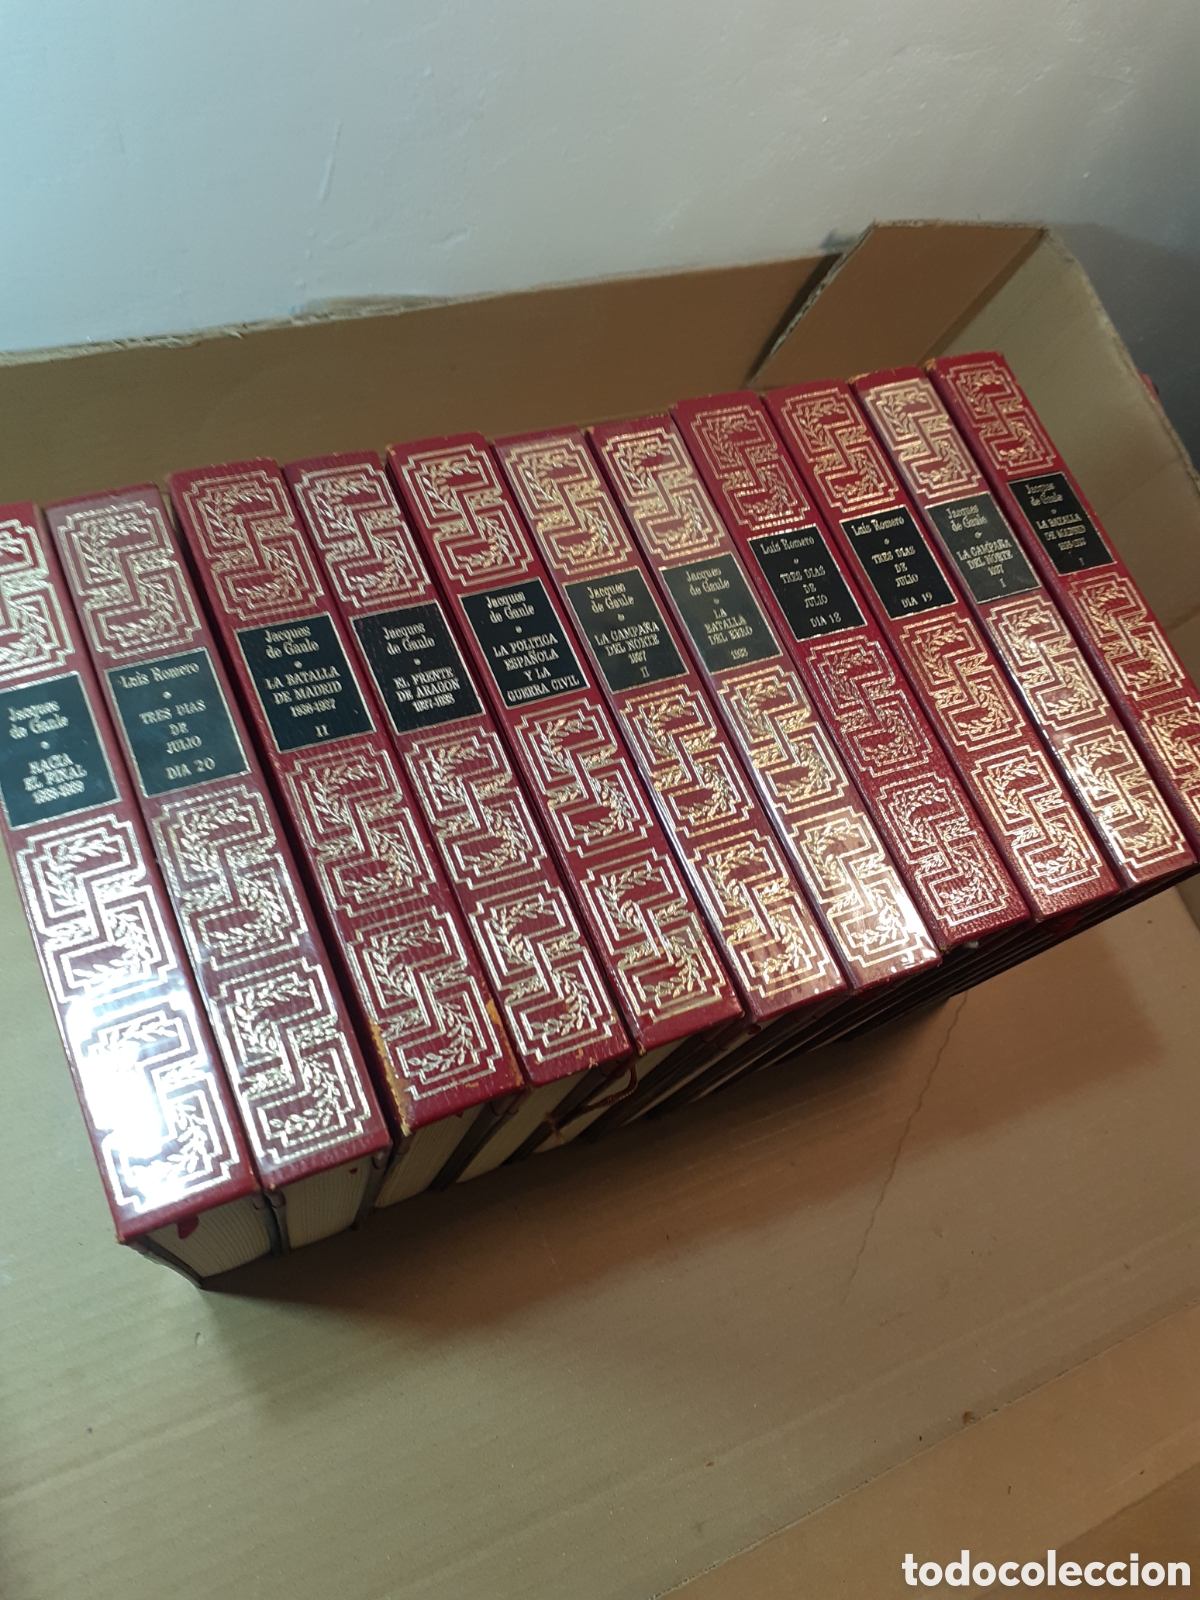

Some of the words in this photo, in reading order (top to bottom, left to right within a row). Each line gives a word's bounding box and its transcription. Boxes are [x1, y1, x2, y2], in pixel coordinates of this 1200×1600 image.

[946, 505, 979, 519] Jacques
[851, 522, 872, 536] Luis
[871, 516, 904, 531] Romero
[950, 520, 962, 532] de
[1036, 520, 1049, 529] LA
[760, 541, 781, 555] Luis
[781, 536, 814, 550] Romero
[872, 551, 894, 564] TRES
[895, 546, 916, 558] DIAS
[956, 550, 971, 560] LA
[970, 539, 1012, 557] CAMPAÑA
[894, 562, 907, 573] DE
[966, 557, 985, 570] DEL
[984, 550, 1013, 565] NORTE
[686, 568, 721, 582] Jacques
[780, 571, 802, 584] TRES
[804, 565, 825, 579] DIAS
[895, 573, 918, 587] JULIO
[587, 583, 626, 599] Jacques
[689, 584, 702, 596] de
[702, 578, 730, 593] Gaule
[803, 583, 816, 594] DE
[485, 592, 526, 609] Jacques
[591, 600, 604, 613] de
[605, 594, 634, 610] Gaule
[804, 594, 828, 608] JULIO
[901, 596, 918, 608] DIA
[921, 592, 932, 602] 19
[489, 610, 503, 623] de
[504, 603, 535, 620] Gaule
[713, 608, 728, 619] LA
[810, 616, 827, 628] DIA
[829, 612, 841, 623] 18
[382, 623, 426, 640] Jacques
[594, 633, 611, 646] LA
[610, 621, 660, 641] CAMPAÑA
[704, 614, 747, 634] BATALLA
[265, 626, 311, 642] Jacques
[708, 632, 728, 645] DEL
[266, 644, 282, 659] de
[283, 638, 319, 655] Gaule
[387, 642, 401, 655] de
[402, 634, 435, 652] Gaule
[492, 645, 509, 657] LA
[509, 633, 558, 653] POLITICA
[604, 642, 626, 656] DEL
[625, 633, 660, 652] NORTE
[503, 648, 560, 671] ESPAÑOLA
[119, 671, 150, 689] Luis
[150, 663, 199, 682] Romero
[264, 676, 284, 690] LA
[284, 666, 341, 686] BATALLA
[393, 676, 410, 689] EL
[410, 666, 454, 685] FRENTE
[523, 670, 533, 682] Y
[535, 666, 551, 679] LA
[640, 666, 650, 678] II
[272, 691, 292, 705] DE
[293, 681, 342, 700] MADRID
[395, 689, 414, 702] DE
[414, 677, 460, 698] ARAGON
[507, 683, 550, 702] GUERRA
[551, 674, 580, 690] CIVIL
[139, 708, 172, 724] TRES
[175, 699, 206, 716] DIAS
[169, 722, 188, 736] DE
[315, 724, 329, 737] II
[166, 735, 202, 754] JULIO
[44, 764, 87, 785] FINAL
[165, 764, 192, 780] DIA
[194, 757, 215, 772] 20
